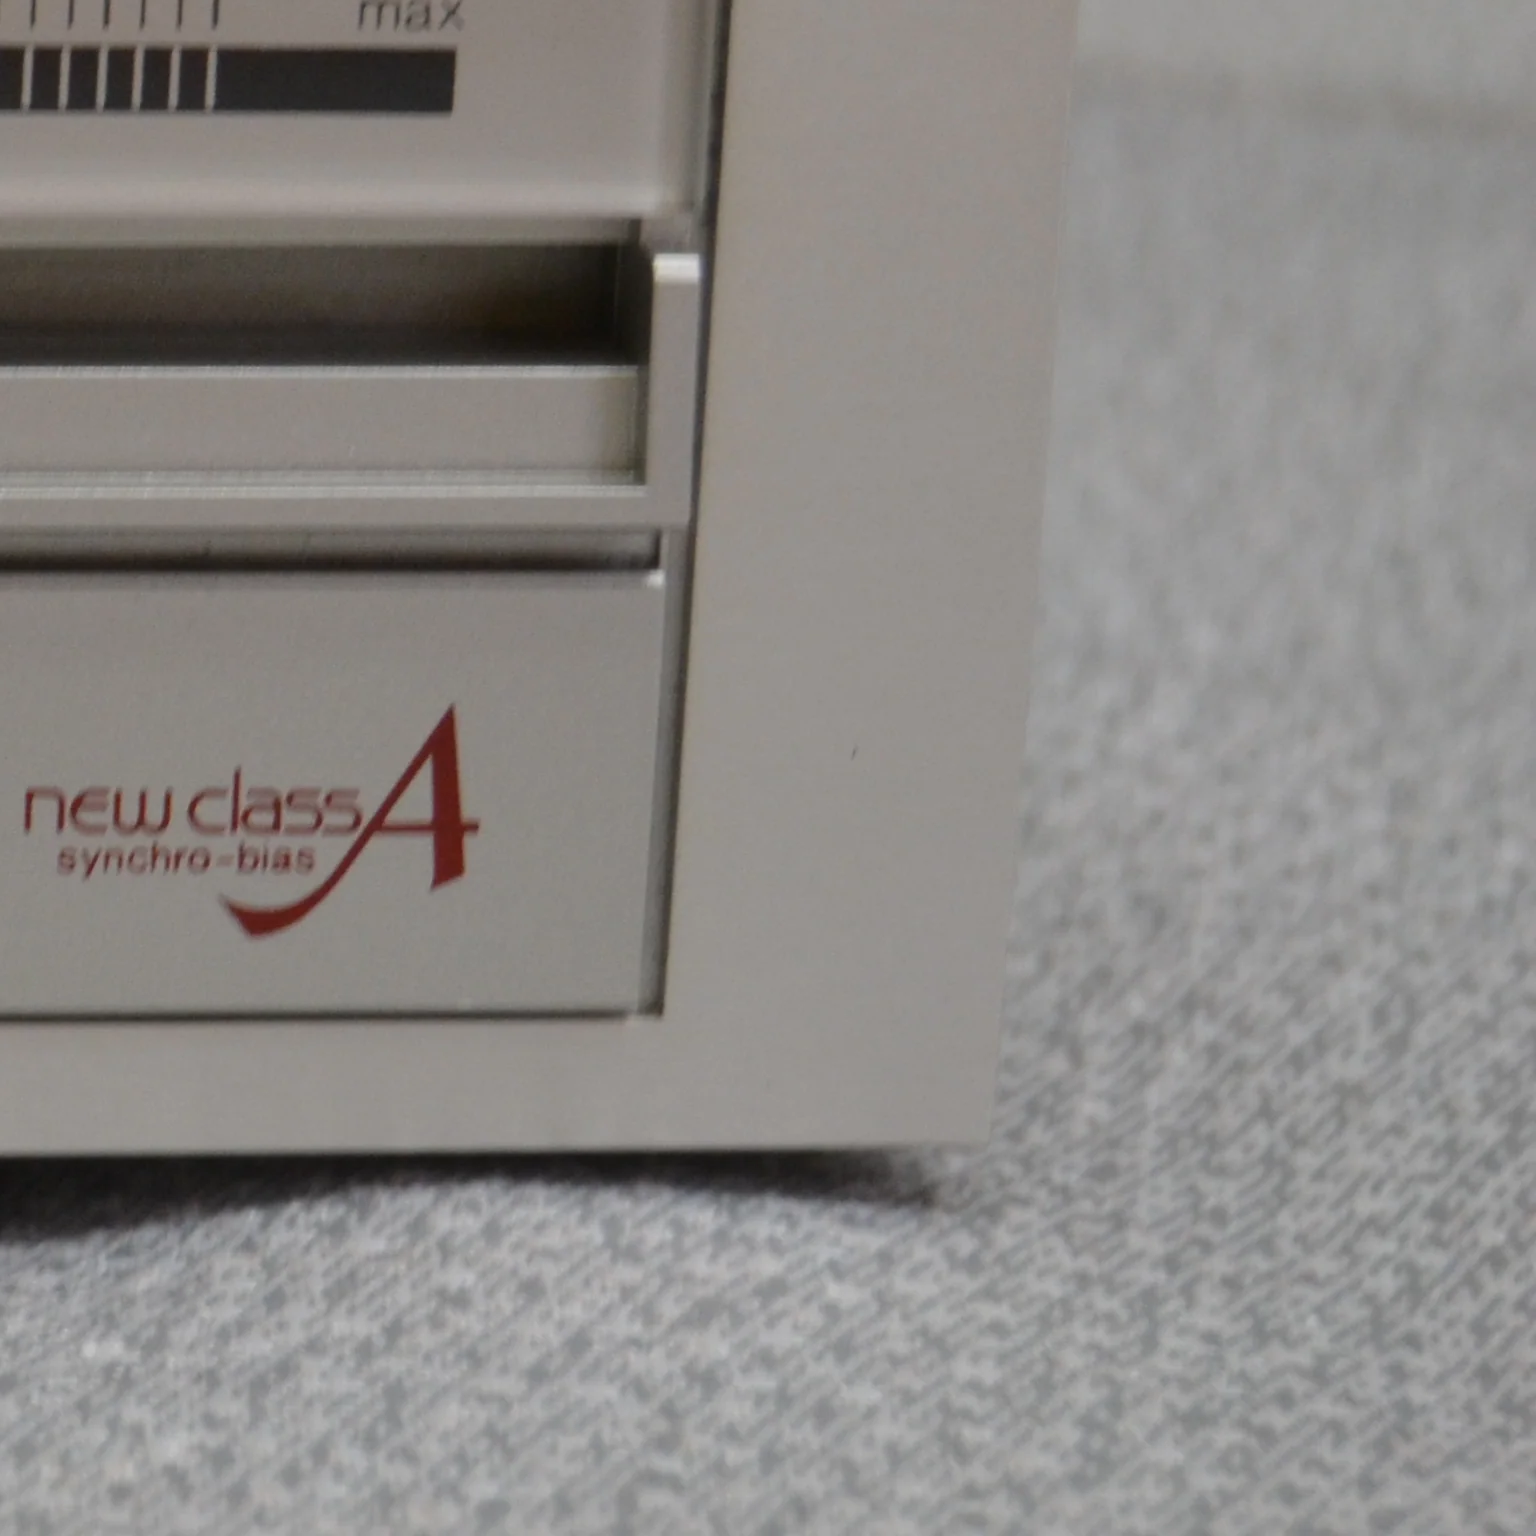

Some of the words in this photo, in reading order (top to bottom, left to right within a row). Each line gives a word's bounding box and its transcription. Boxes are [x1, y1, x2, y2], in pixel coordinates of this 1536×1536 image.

[23, 788, 175, 838] new
[185, 764, 365, 837] class
[217, 701, 483, 942] A
